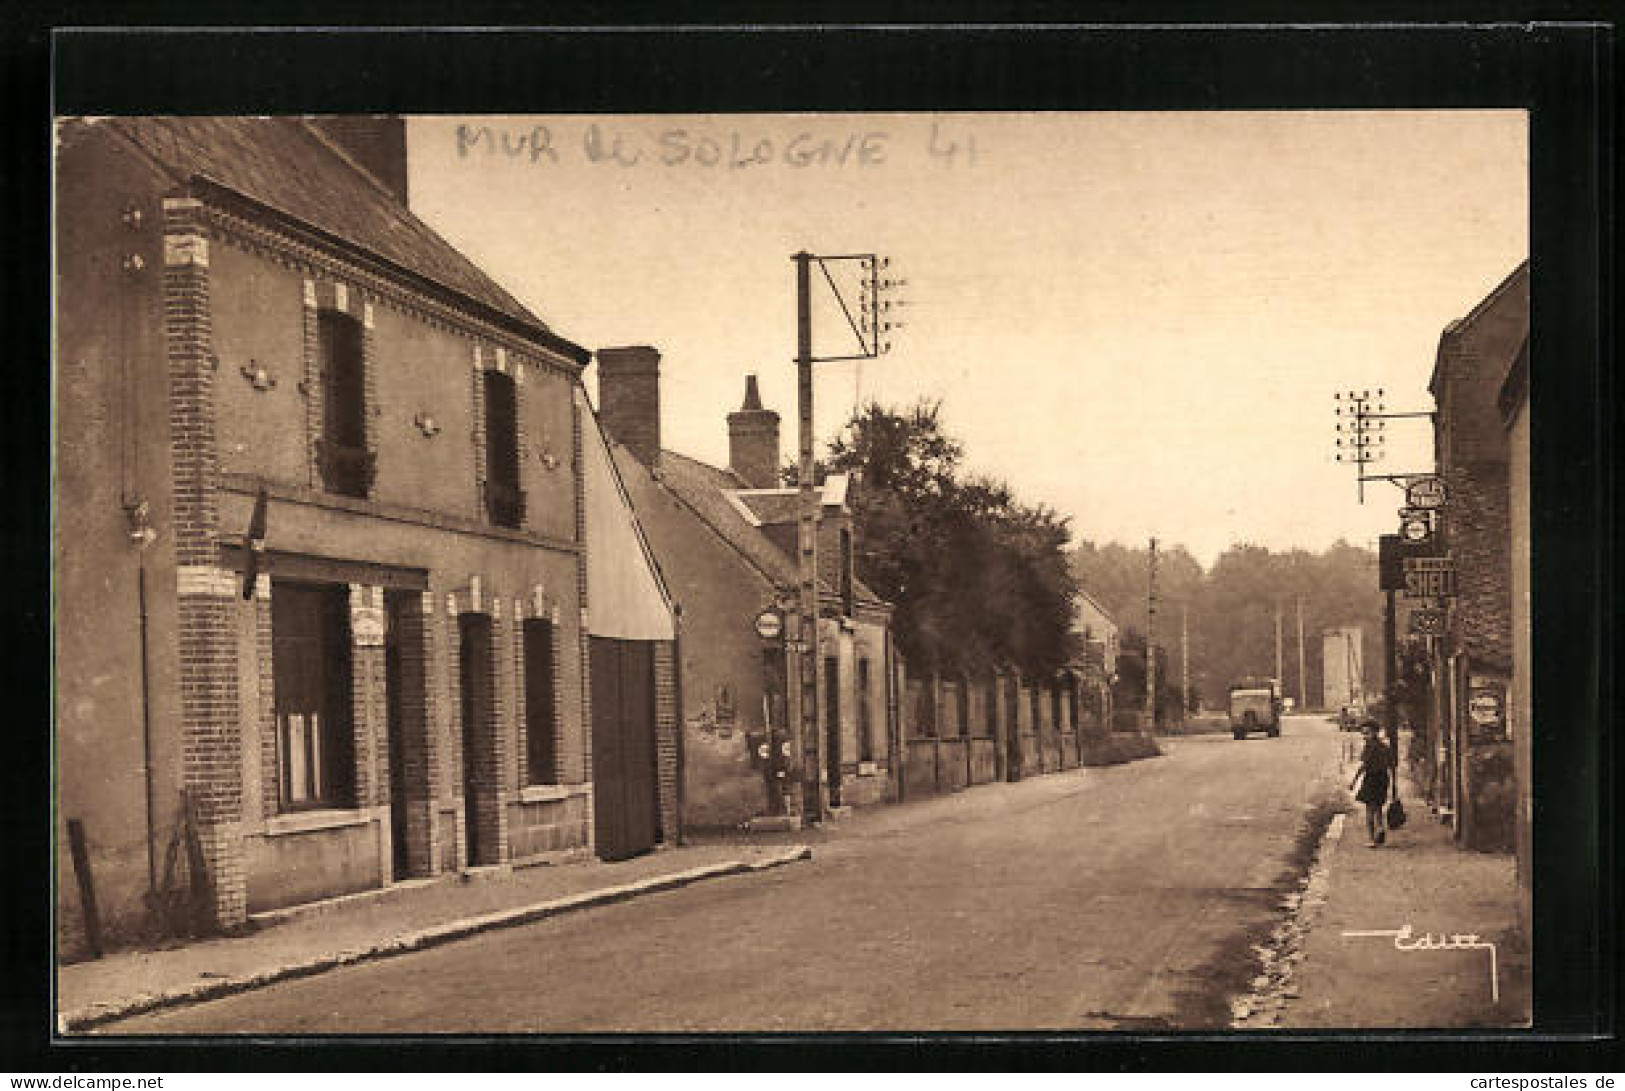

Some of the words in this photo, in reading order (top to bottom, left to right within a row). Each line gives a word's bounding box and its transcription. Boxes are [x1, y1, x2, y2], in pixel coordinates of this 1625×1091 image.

[456, 123, 559, 164] MUR
[658, 128, 888, 169] SOLOGNE
[927, 121, 978, 170] 41
